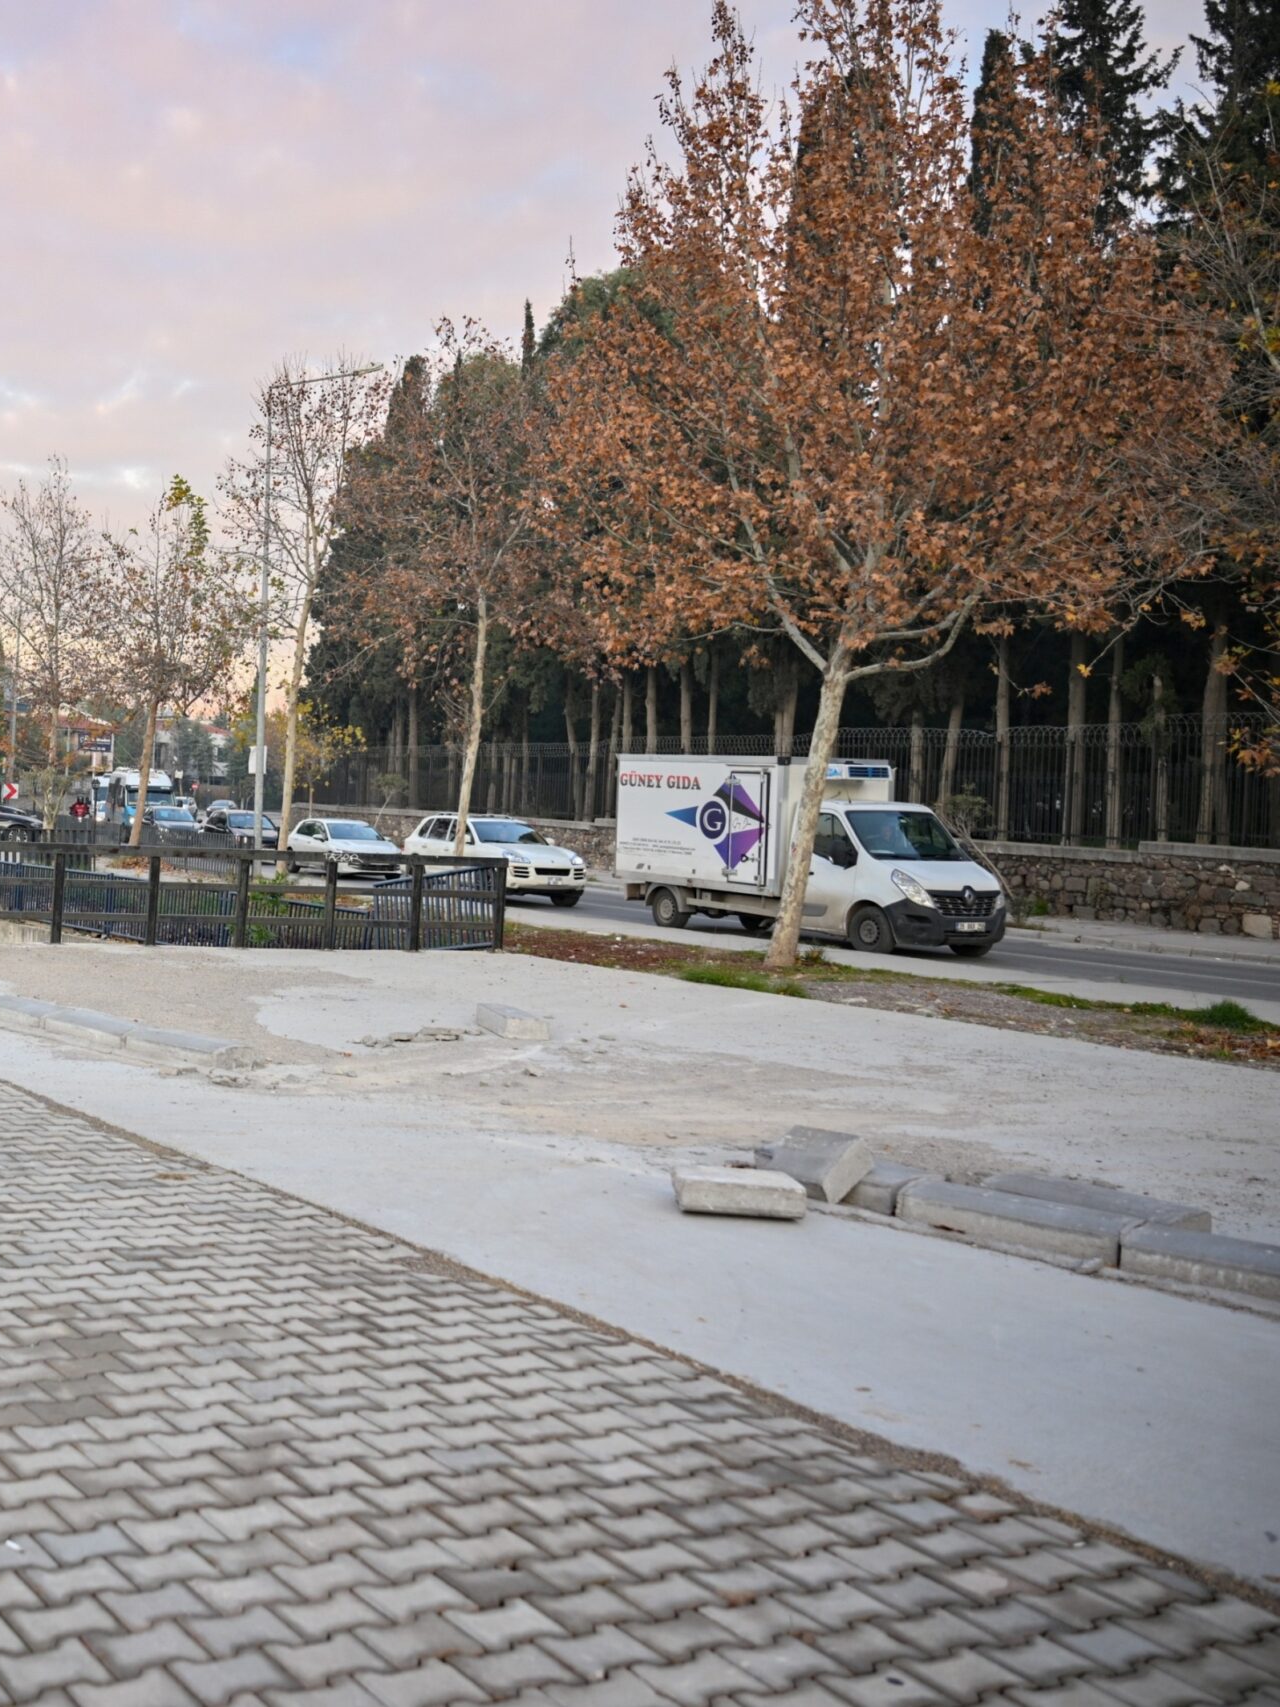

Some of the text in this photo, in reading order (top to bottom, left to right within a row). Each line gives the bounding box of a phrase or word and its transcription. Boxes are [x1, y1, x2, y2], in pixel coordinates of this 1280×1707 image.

[620, 770, 702, 790] GÜNEY GIDA
[703, 808, 723, 832] G
